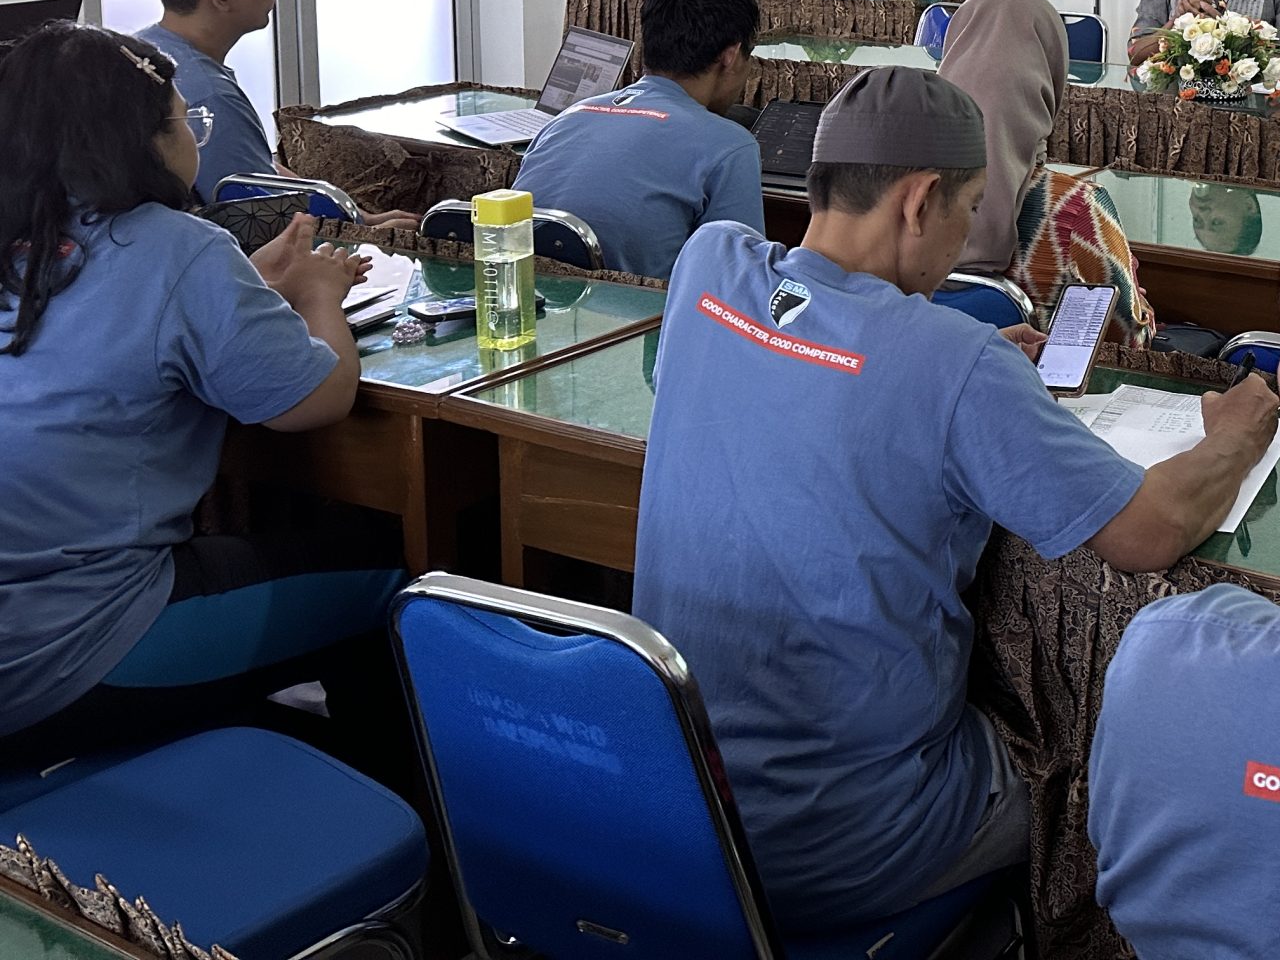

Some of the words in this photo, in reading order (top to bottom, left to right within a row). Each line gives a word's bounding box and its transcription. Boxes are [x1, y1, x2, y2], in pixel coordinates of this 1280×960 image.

[481, 231, 497, 254] MY
[783, 281, 809, 297] SMA
[701, 298, 723, 316] GOOD
[721, 312, 769, 344] CHARACTER,
[769, 336, 792, 350] GOOD
[791, 343, 860, 369] COMPETENCE
